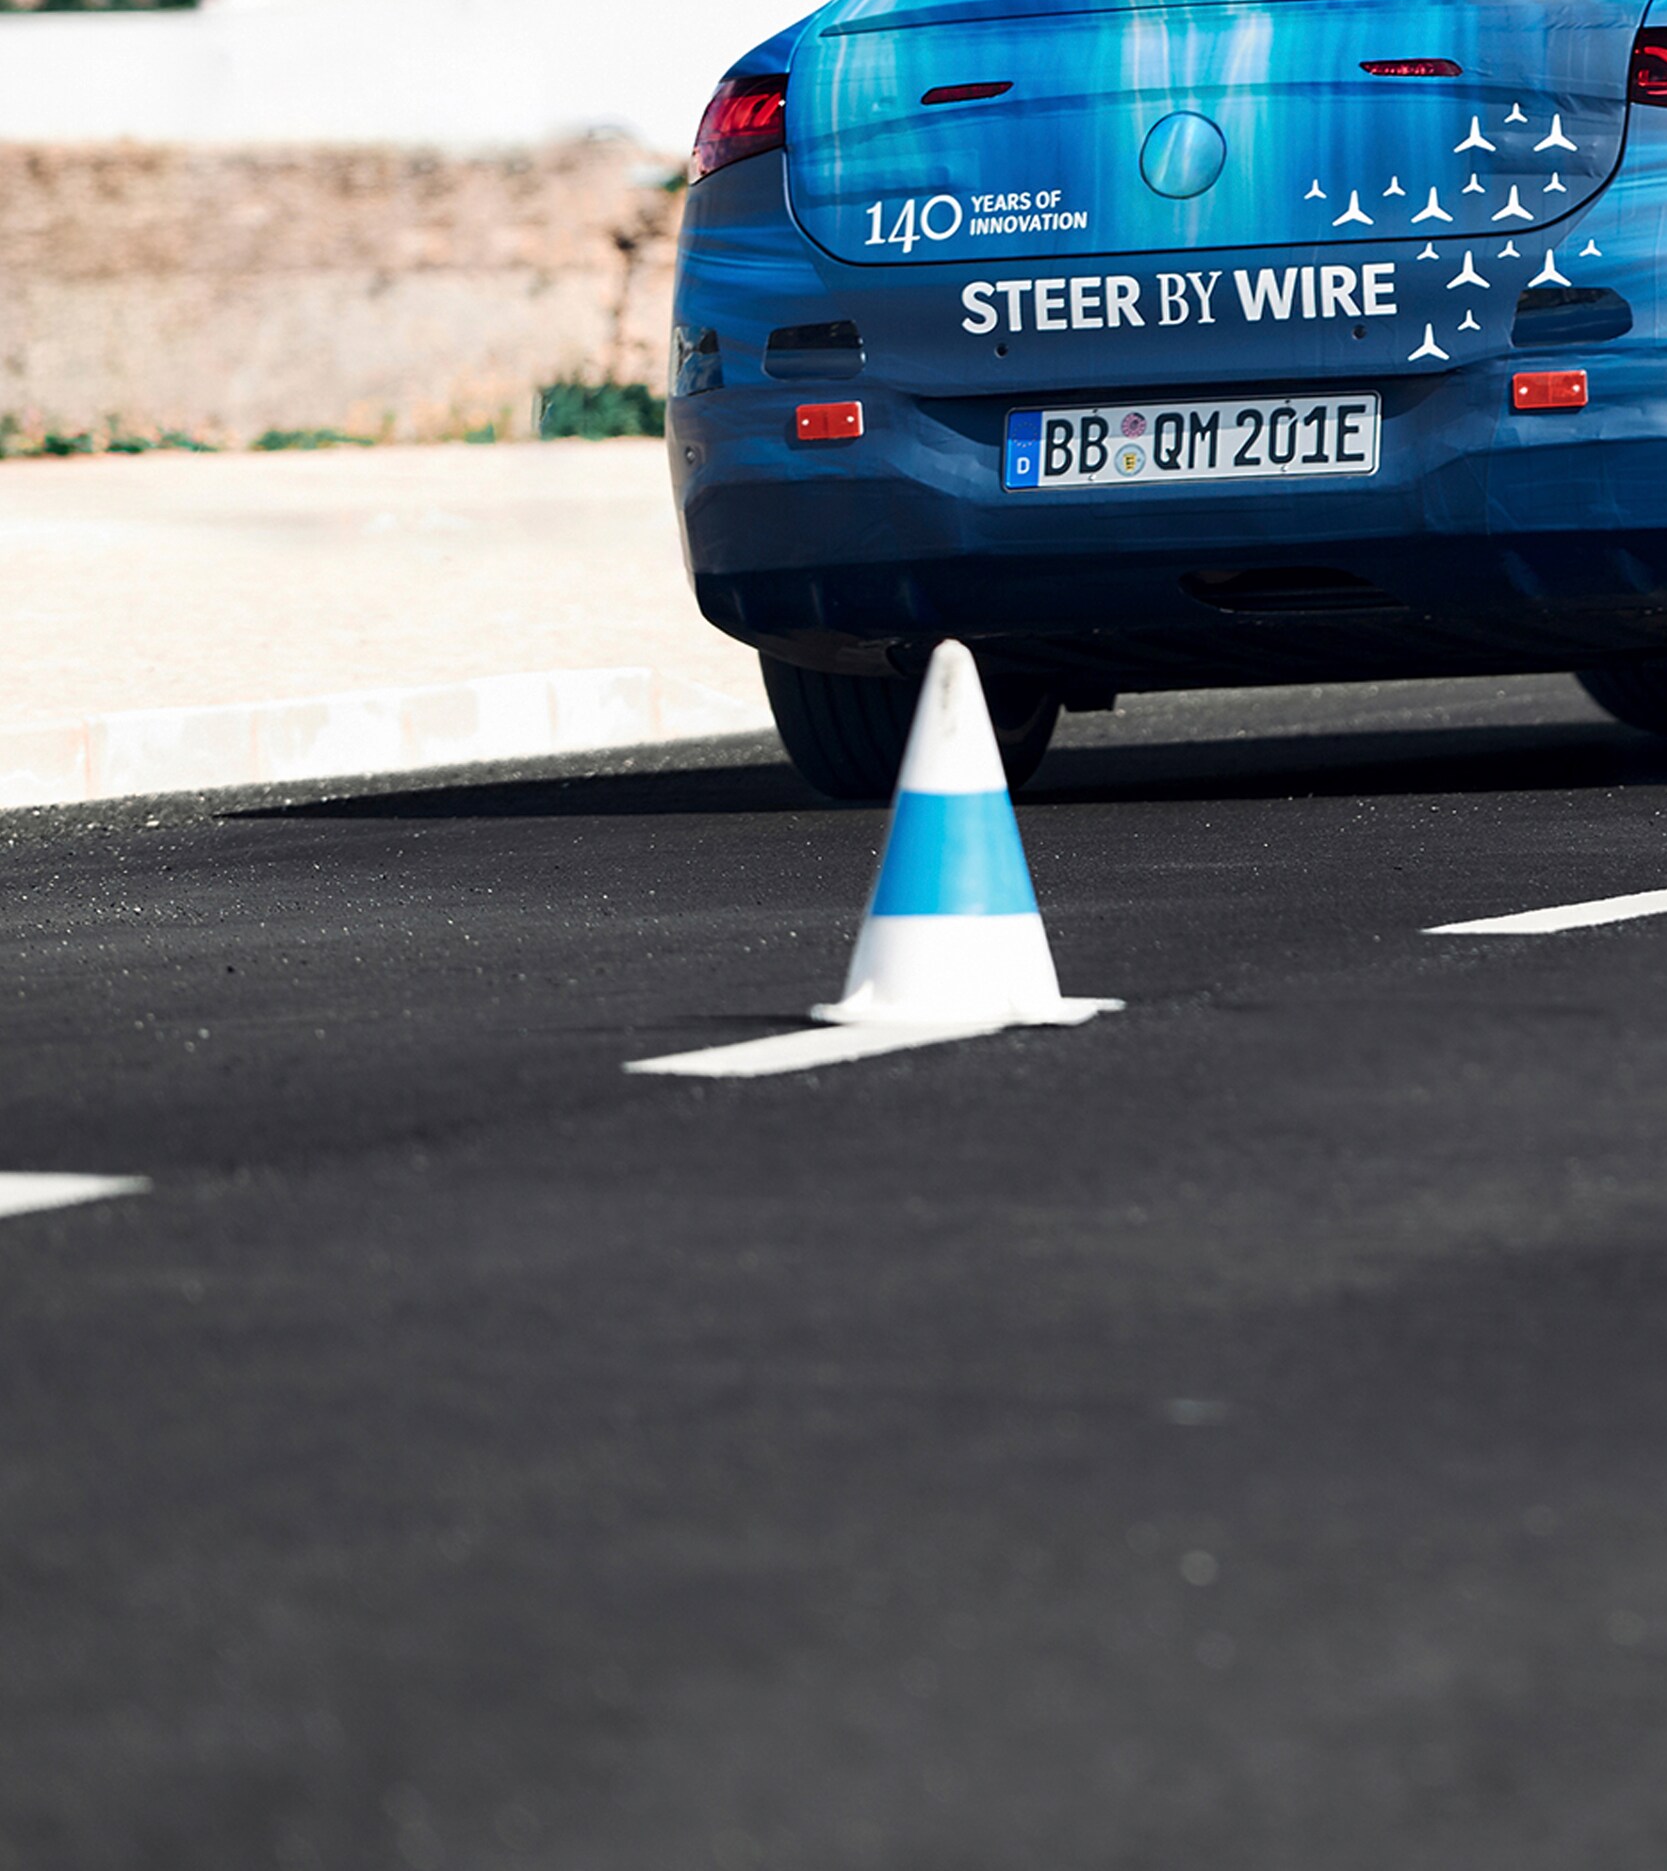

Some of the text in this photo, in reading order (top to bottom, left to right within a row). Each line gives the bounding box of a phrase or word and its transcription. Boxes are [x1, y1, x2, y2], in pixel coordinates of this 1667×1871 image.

[971, 190, 1062, 213] YEARS OF
[864, 194, 963, 253] 140
[969, 211, 1088, 236] INNOVATION
[961, 262, 1398, 335] STEER BY WIRE
[1044, 404, 1367, 477] BB QM 201E
[1016, 457, 1031, 475] D
